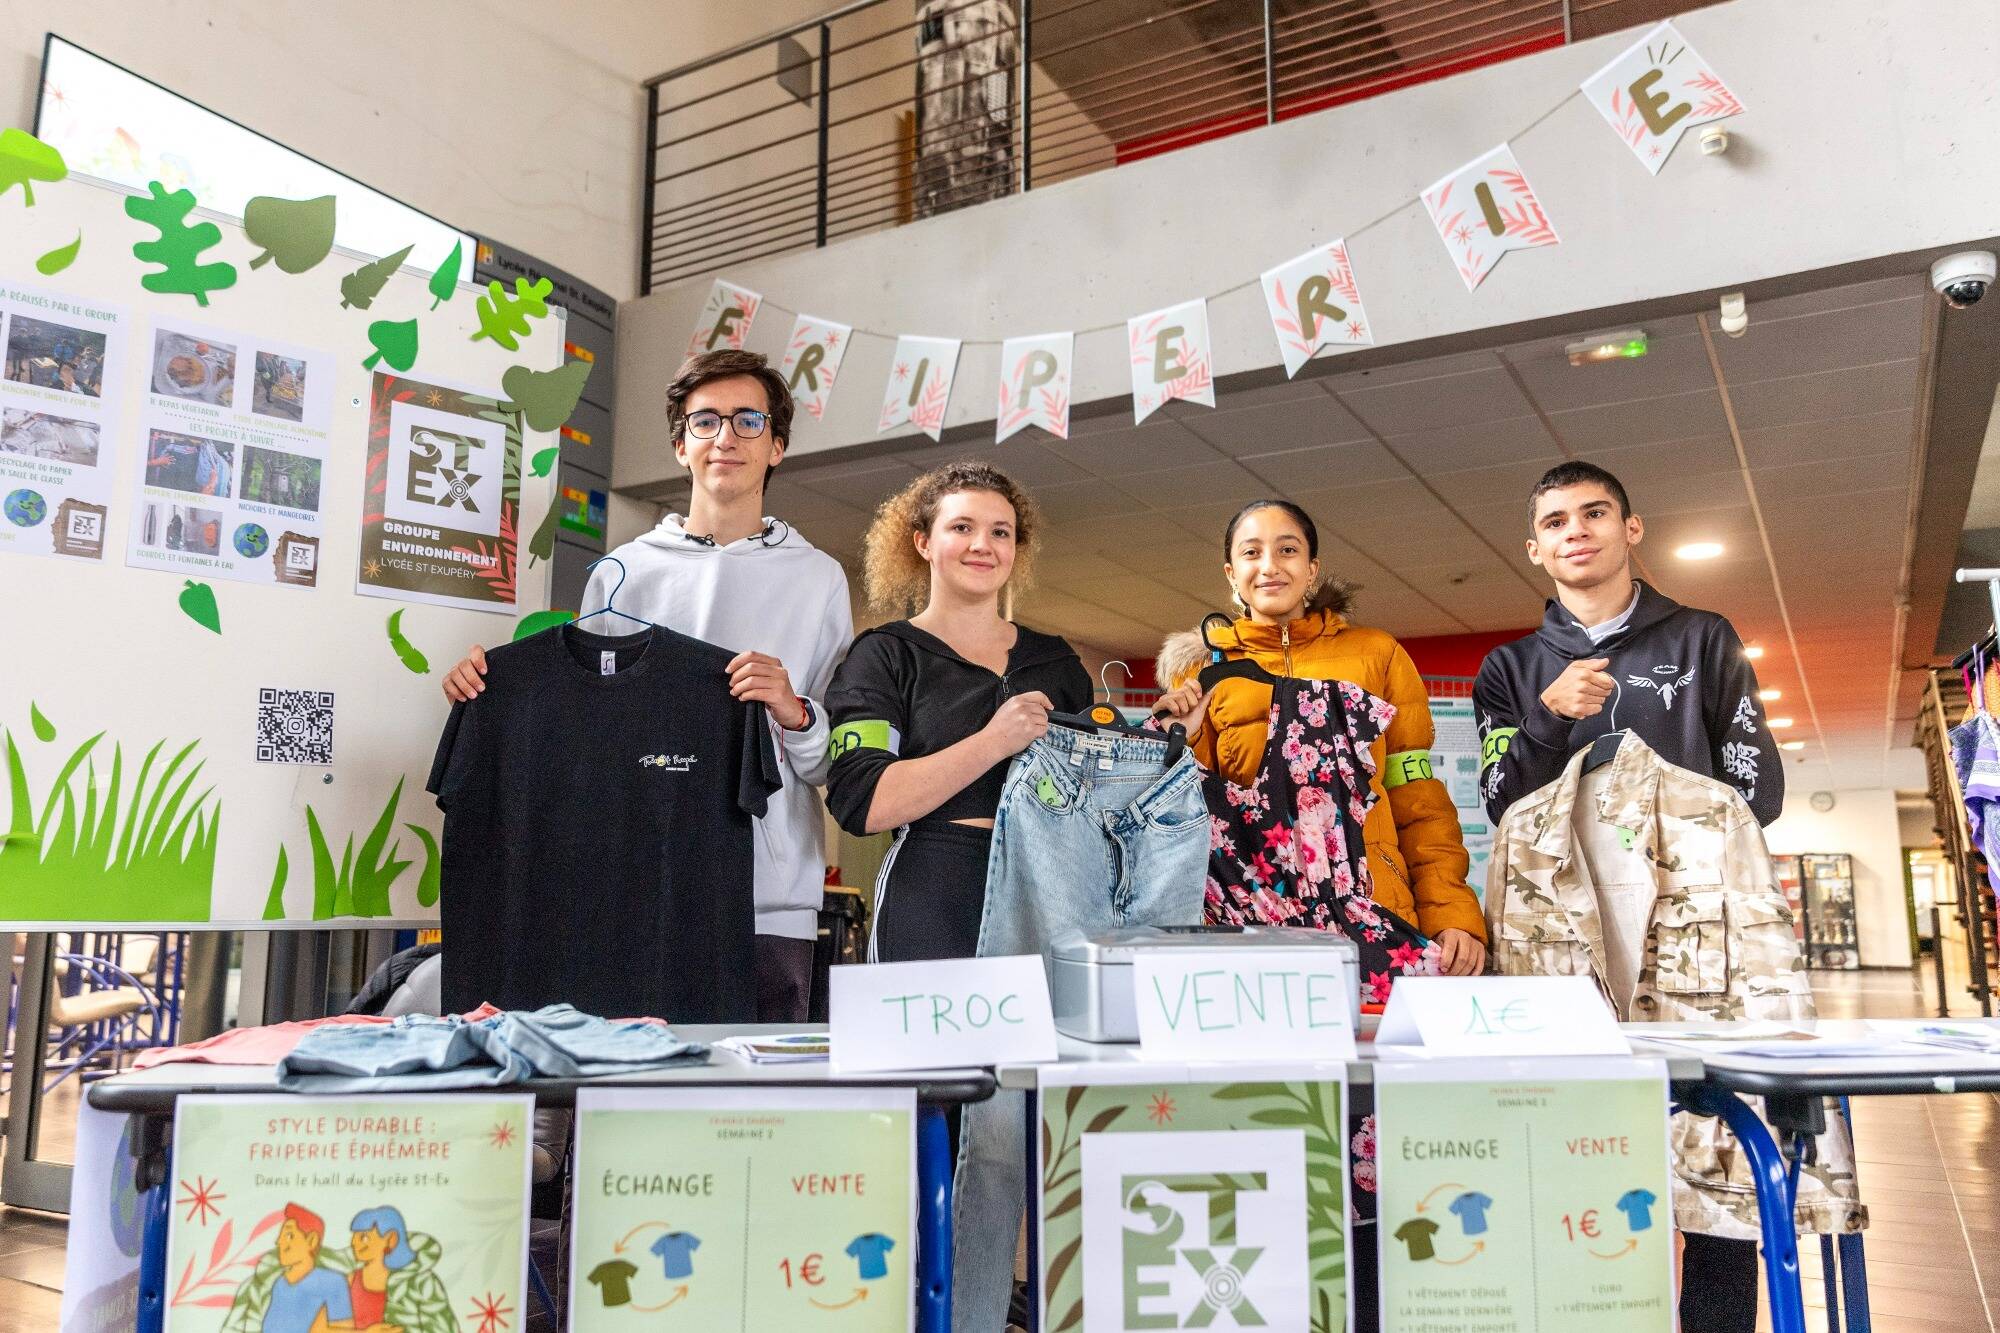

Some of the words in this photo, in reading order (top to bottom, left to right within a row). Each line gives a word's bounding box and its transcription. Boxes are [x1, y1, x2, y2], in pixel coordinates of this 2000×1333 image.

[52, 300, 70, 313] PAR
[72, 305, 82, 316] LE
[85, 308, 119, 322] GROUPE
[189, 422, 204, 434] LES
[205, 425, 238, 440] PROJETS
[249, 433, 275, 447] SUIVRE
[8, 469, 28, 480] SALLE
[30, 472, 39, 481] DE
[40, 476, 65, 485] CLASSE
[50, 465, 73, 476] PAPIER
[238, 503, 267, 514] NICHOIRS
[268, 507, 276, 515] ET
[277, 508, 316, 522] MANGEOIRES
[383, 521, 441, 541] GROUPE
[168, 553, 177, 562] ET
[221, 560, 234, 570] EAU
[382, 539, 498, 568] ENVIRONNEMENT
[381, 557, 413, 572] LYCÉE
[415, 561, 429, 573] ST
[430, 564, 476, 580] EXUPÉRY
[1152, 969, 1343, 1032] VENTE
[881, 993, 1025, 1035] TROC
[267, 1116, 327, 1136] STYLE
[335, 1116, 424, 1136] DURABLE
[717, 1128, 766, 1140] SEMAINE
[248, 1141, 341, 1161] FRIPERIE
[348, 1136, 451, 1161] ÉPHÉMÈRE
[1402, 1135, 1500, 1161] ÉCHANGE
[1565, 1136, 1630, 1157] VENTE
[254, 1172, 291, 1187] Dans
[296, 1172, 308, 1186] le
[313, 1171, 341, 1187] hall
[346, 1172, 364, 1187] du
[371, 1172, 409, 1192] Lycée
[602, 1168, 715, 1197] ÉCHANGE
[791, 1172, 867, 1197] VENTE
[1560, 1208, 1602, 1242] 1€
[777, 1251, 826, 1290] 1€
[1414, 1286, 1468, 1298] VÊTEMENT
[1400, 1305, 1413, 1316] LA
[1415, 1305, 1461, 1316] SEMAINE
[1464, 1303, 1513, 1315] DERNIÈRE
[1568, 1300, 1618, 1312] VÊTEMENT
[1620, 1297, 1661, 1310] EMPORTÉ
